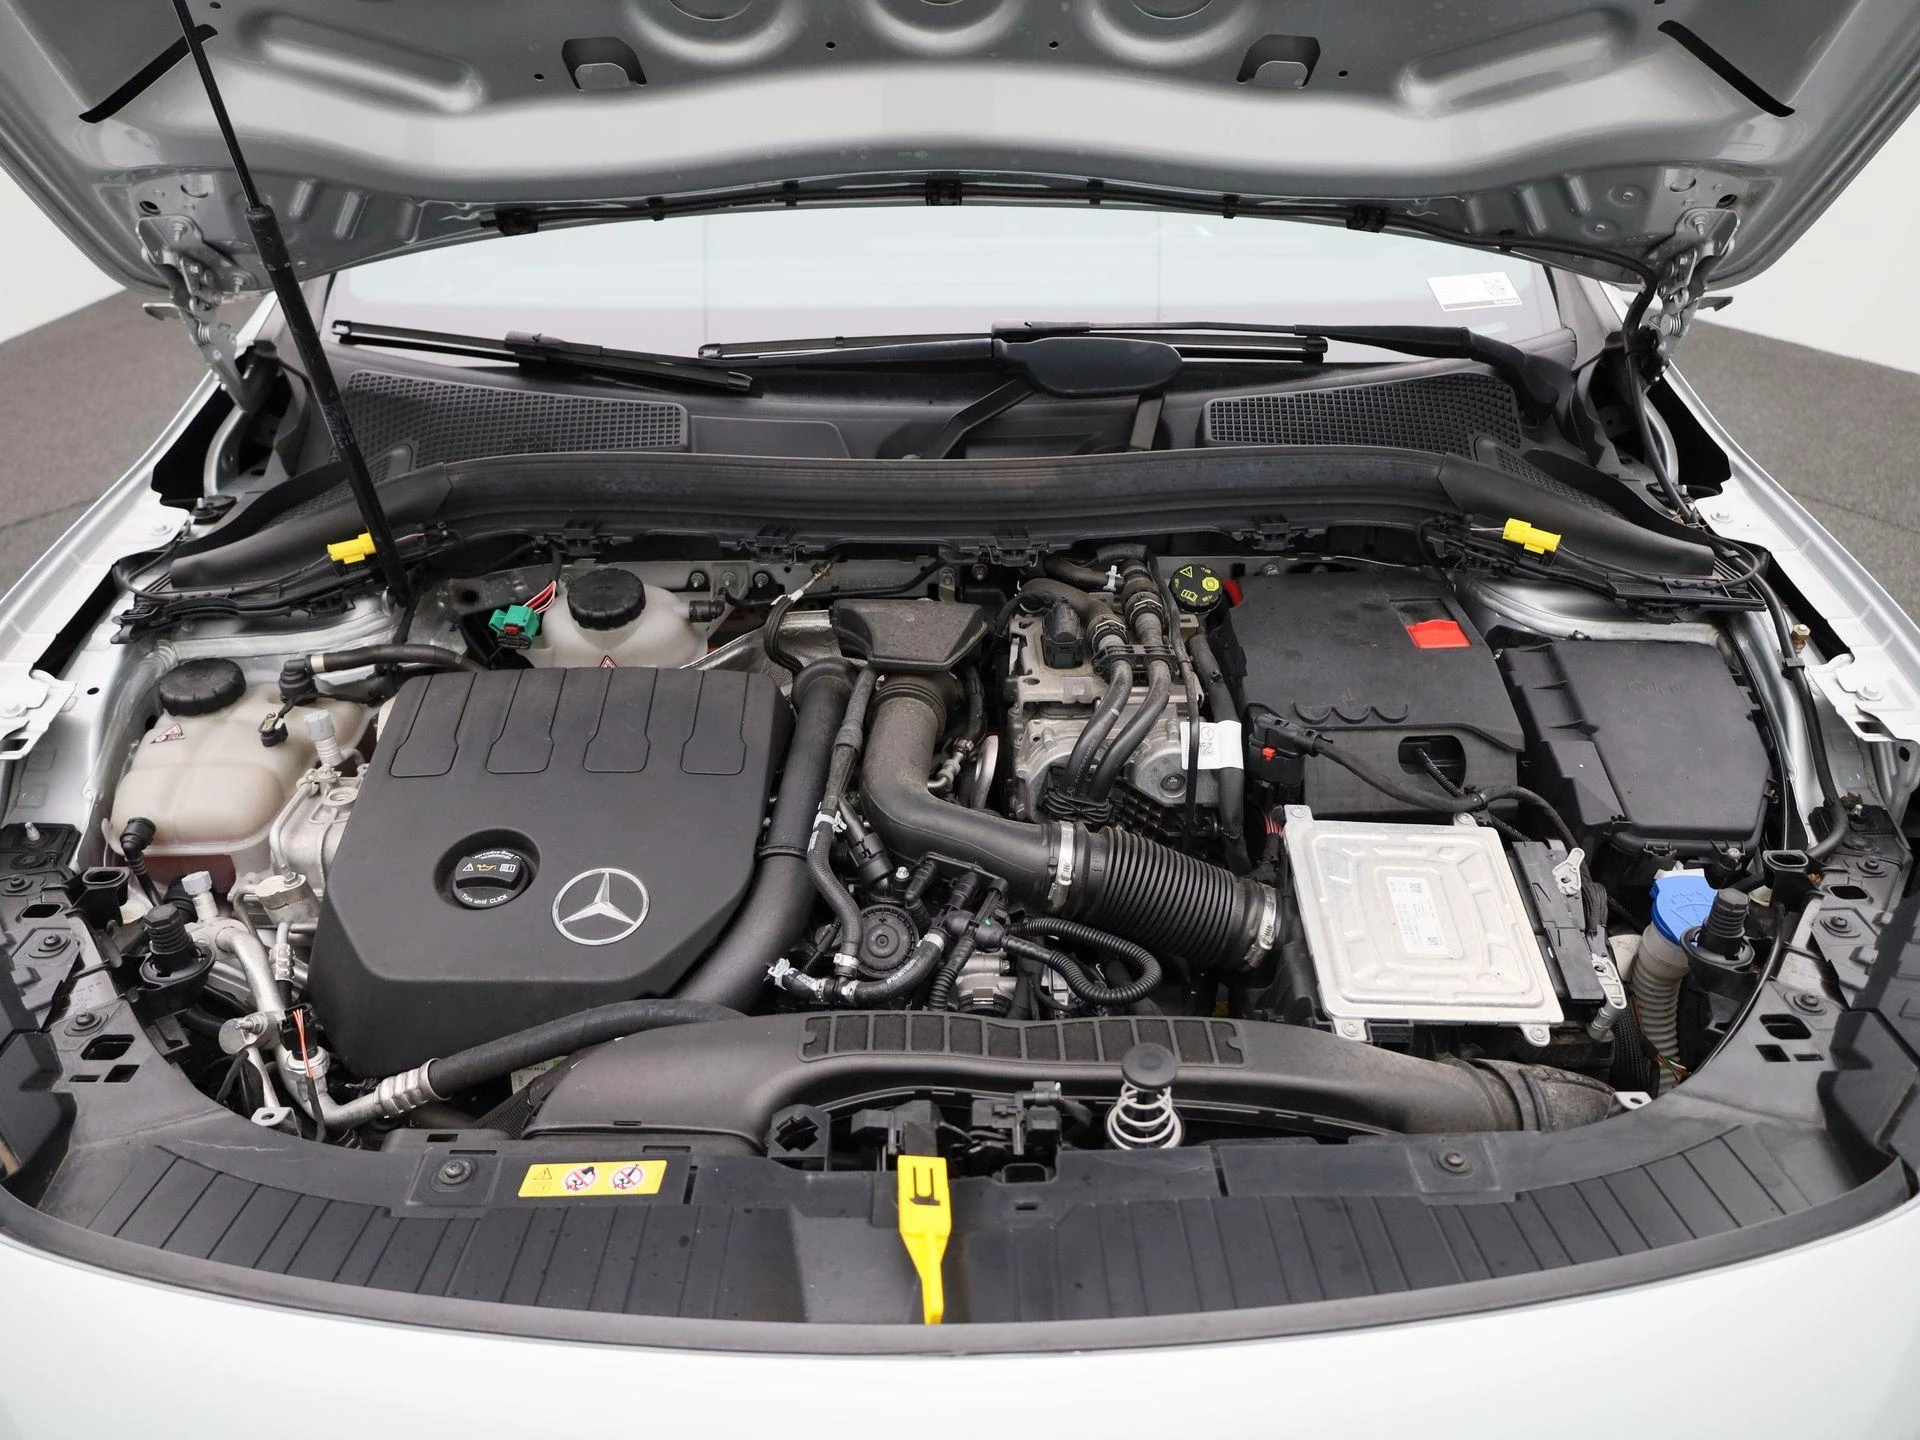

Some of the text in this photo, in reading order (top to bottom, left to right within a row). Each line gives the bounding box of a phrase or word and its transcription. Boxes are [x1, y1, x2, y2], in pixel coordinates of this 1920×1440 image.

[462, 893, 509, 905] Turn until CLICK
